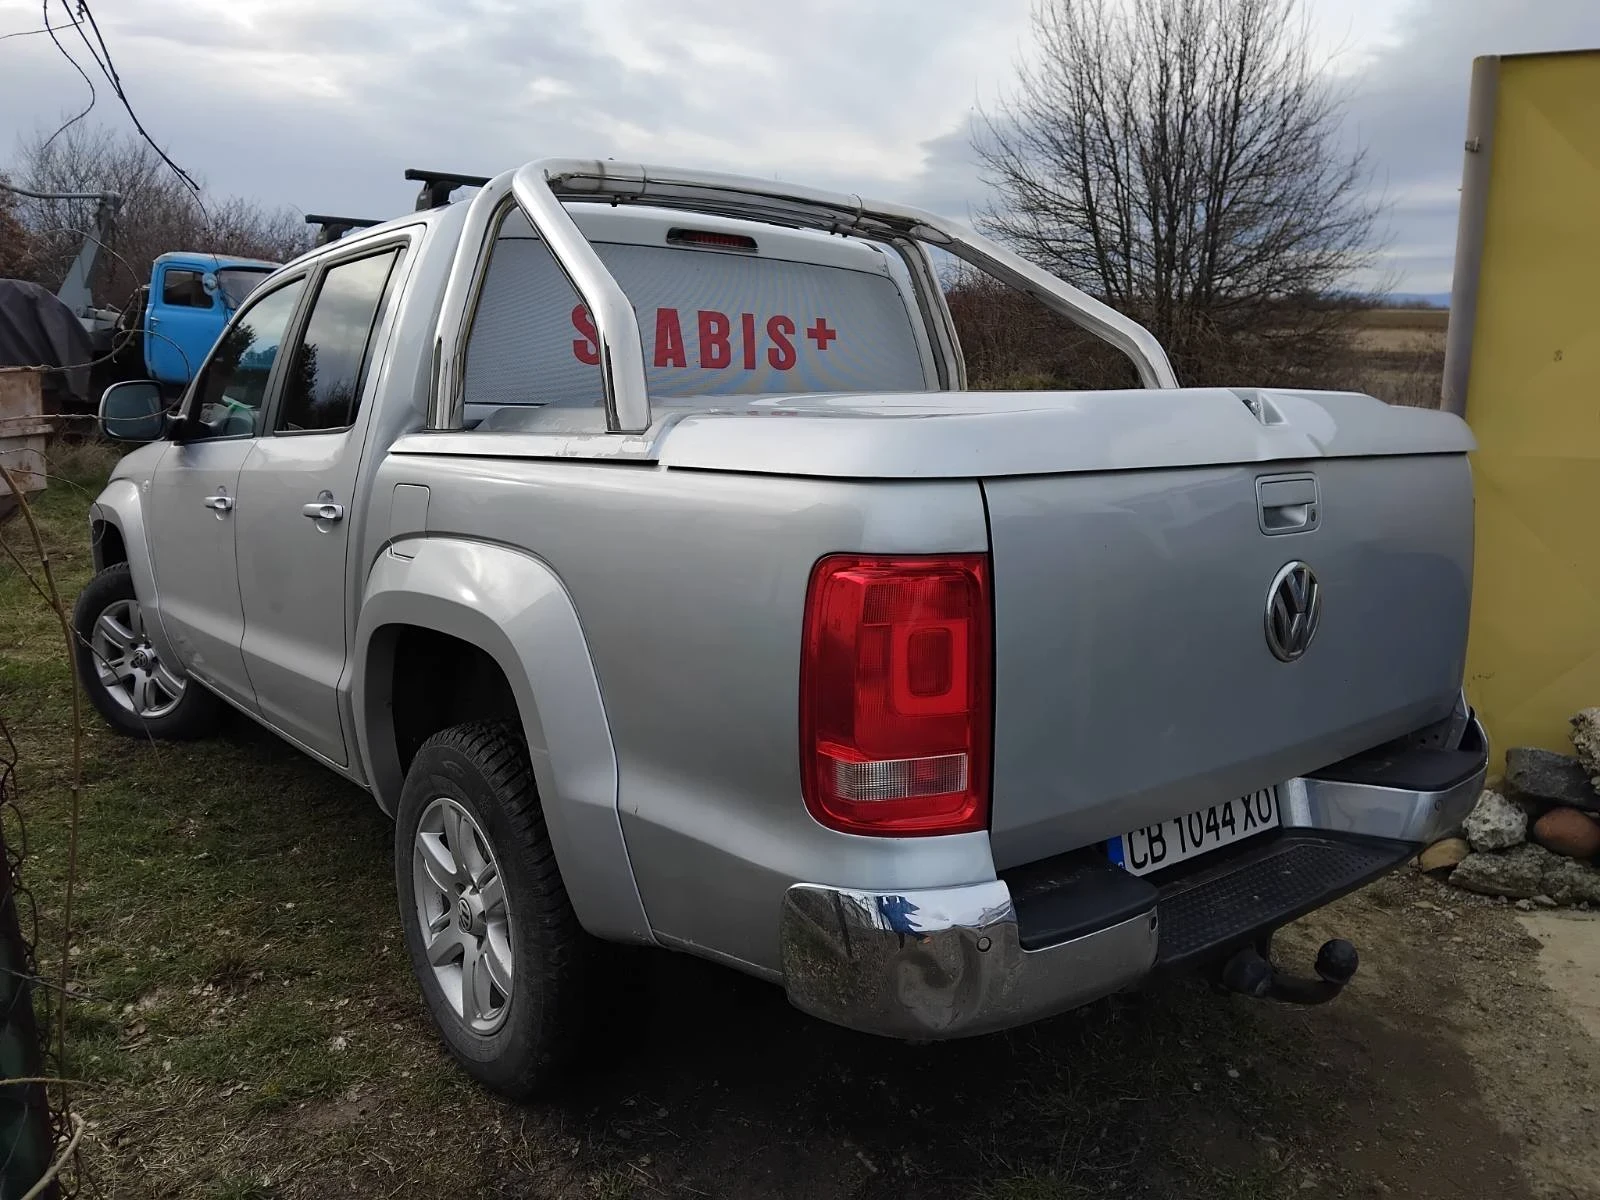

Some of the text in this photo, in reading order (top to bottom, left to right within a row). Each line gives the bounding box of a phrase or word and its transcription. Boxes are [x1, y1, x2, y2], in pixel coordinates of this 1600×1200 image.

[571, 303, 837, 371] SABIS+
[1127, 823, 1167, 870] CB
[1174, 801, 1236, 853] 1044
